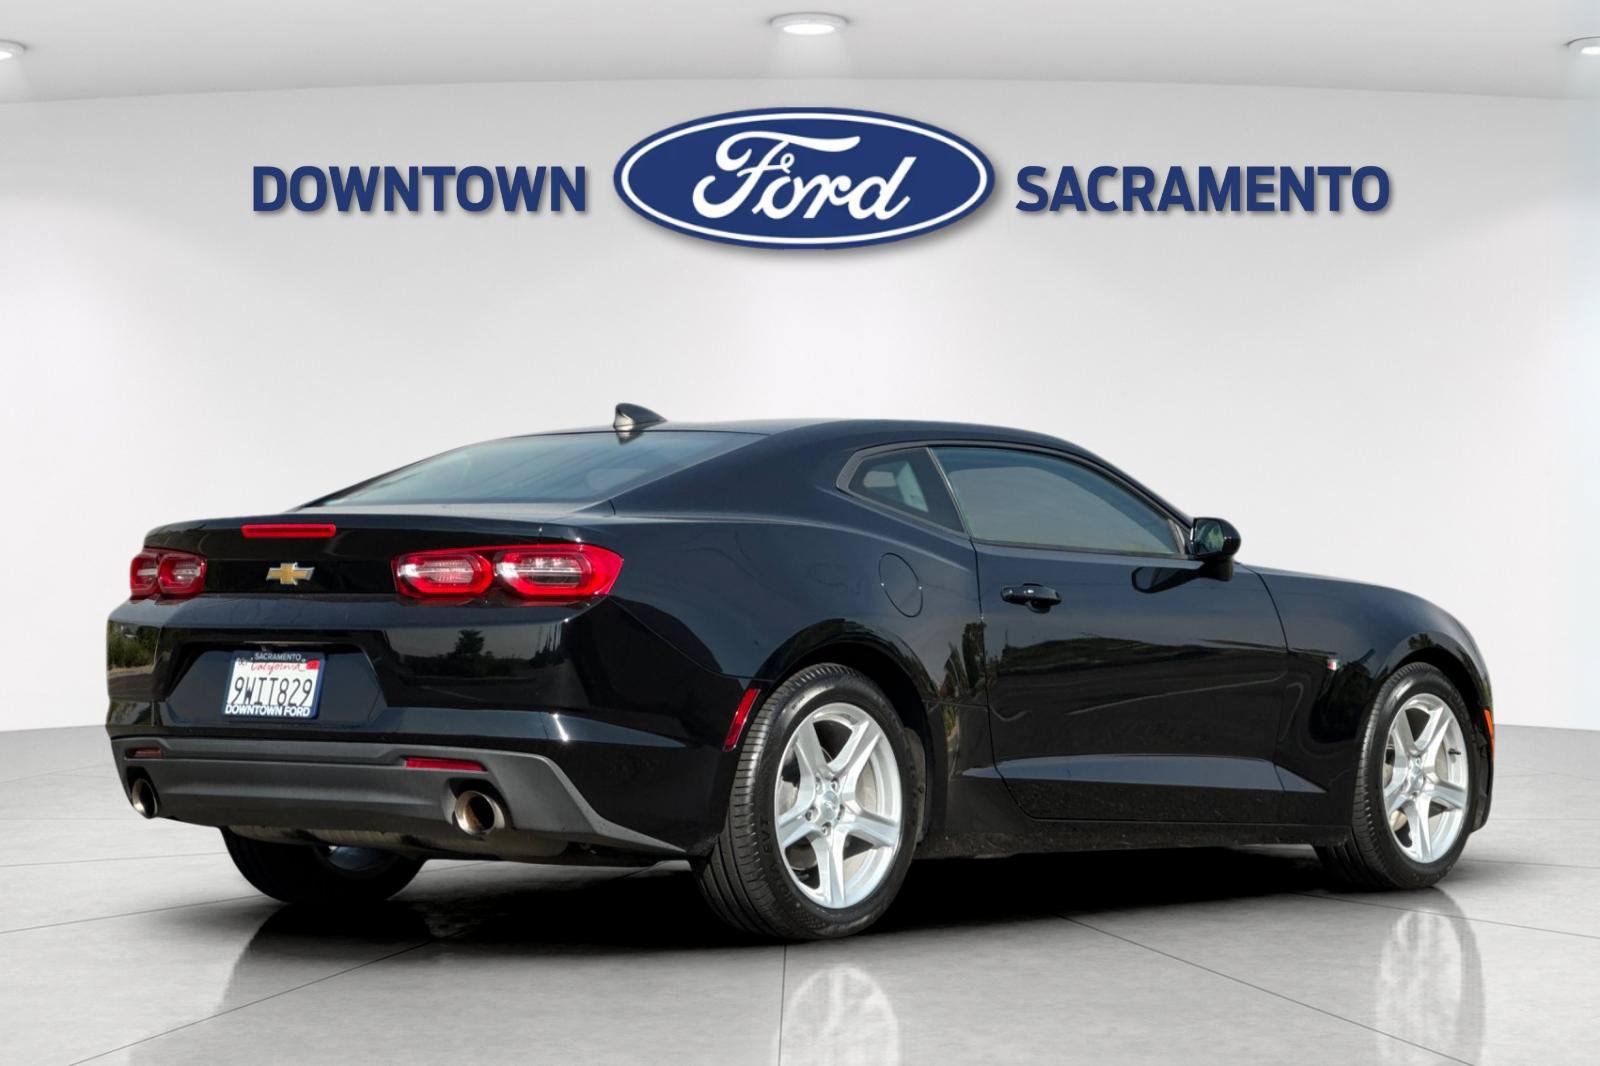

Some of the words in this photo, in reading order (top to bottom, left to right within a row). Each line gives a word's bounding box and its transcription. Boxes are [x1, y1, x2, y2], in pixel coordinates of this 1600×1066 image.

[252, 165, 586, 212] DOWNTOWN
[692, 131, 917, 221] Ford
[1016, 165, 1390, 212] SACRAMENTO
[254, 652, 302, 661] SACRAMENTO
[251, 661, 305, 674] California
[231, 676, 313, 707] 9WIT829
[225, 705, 281, 716] DOWNTOWN
[283, 706, 310, 717] FORD
